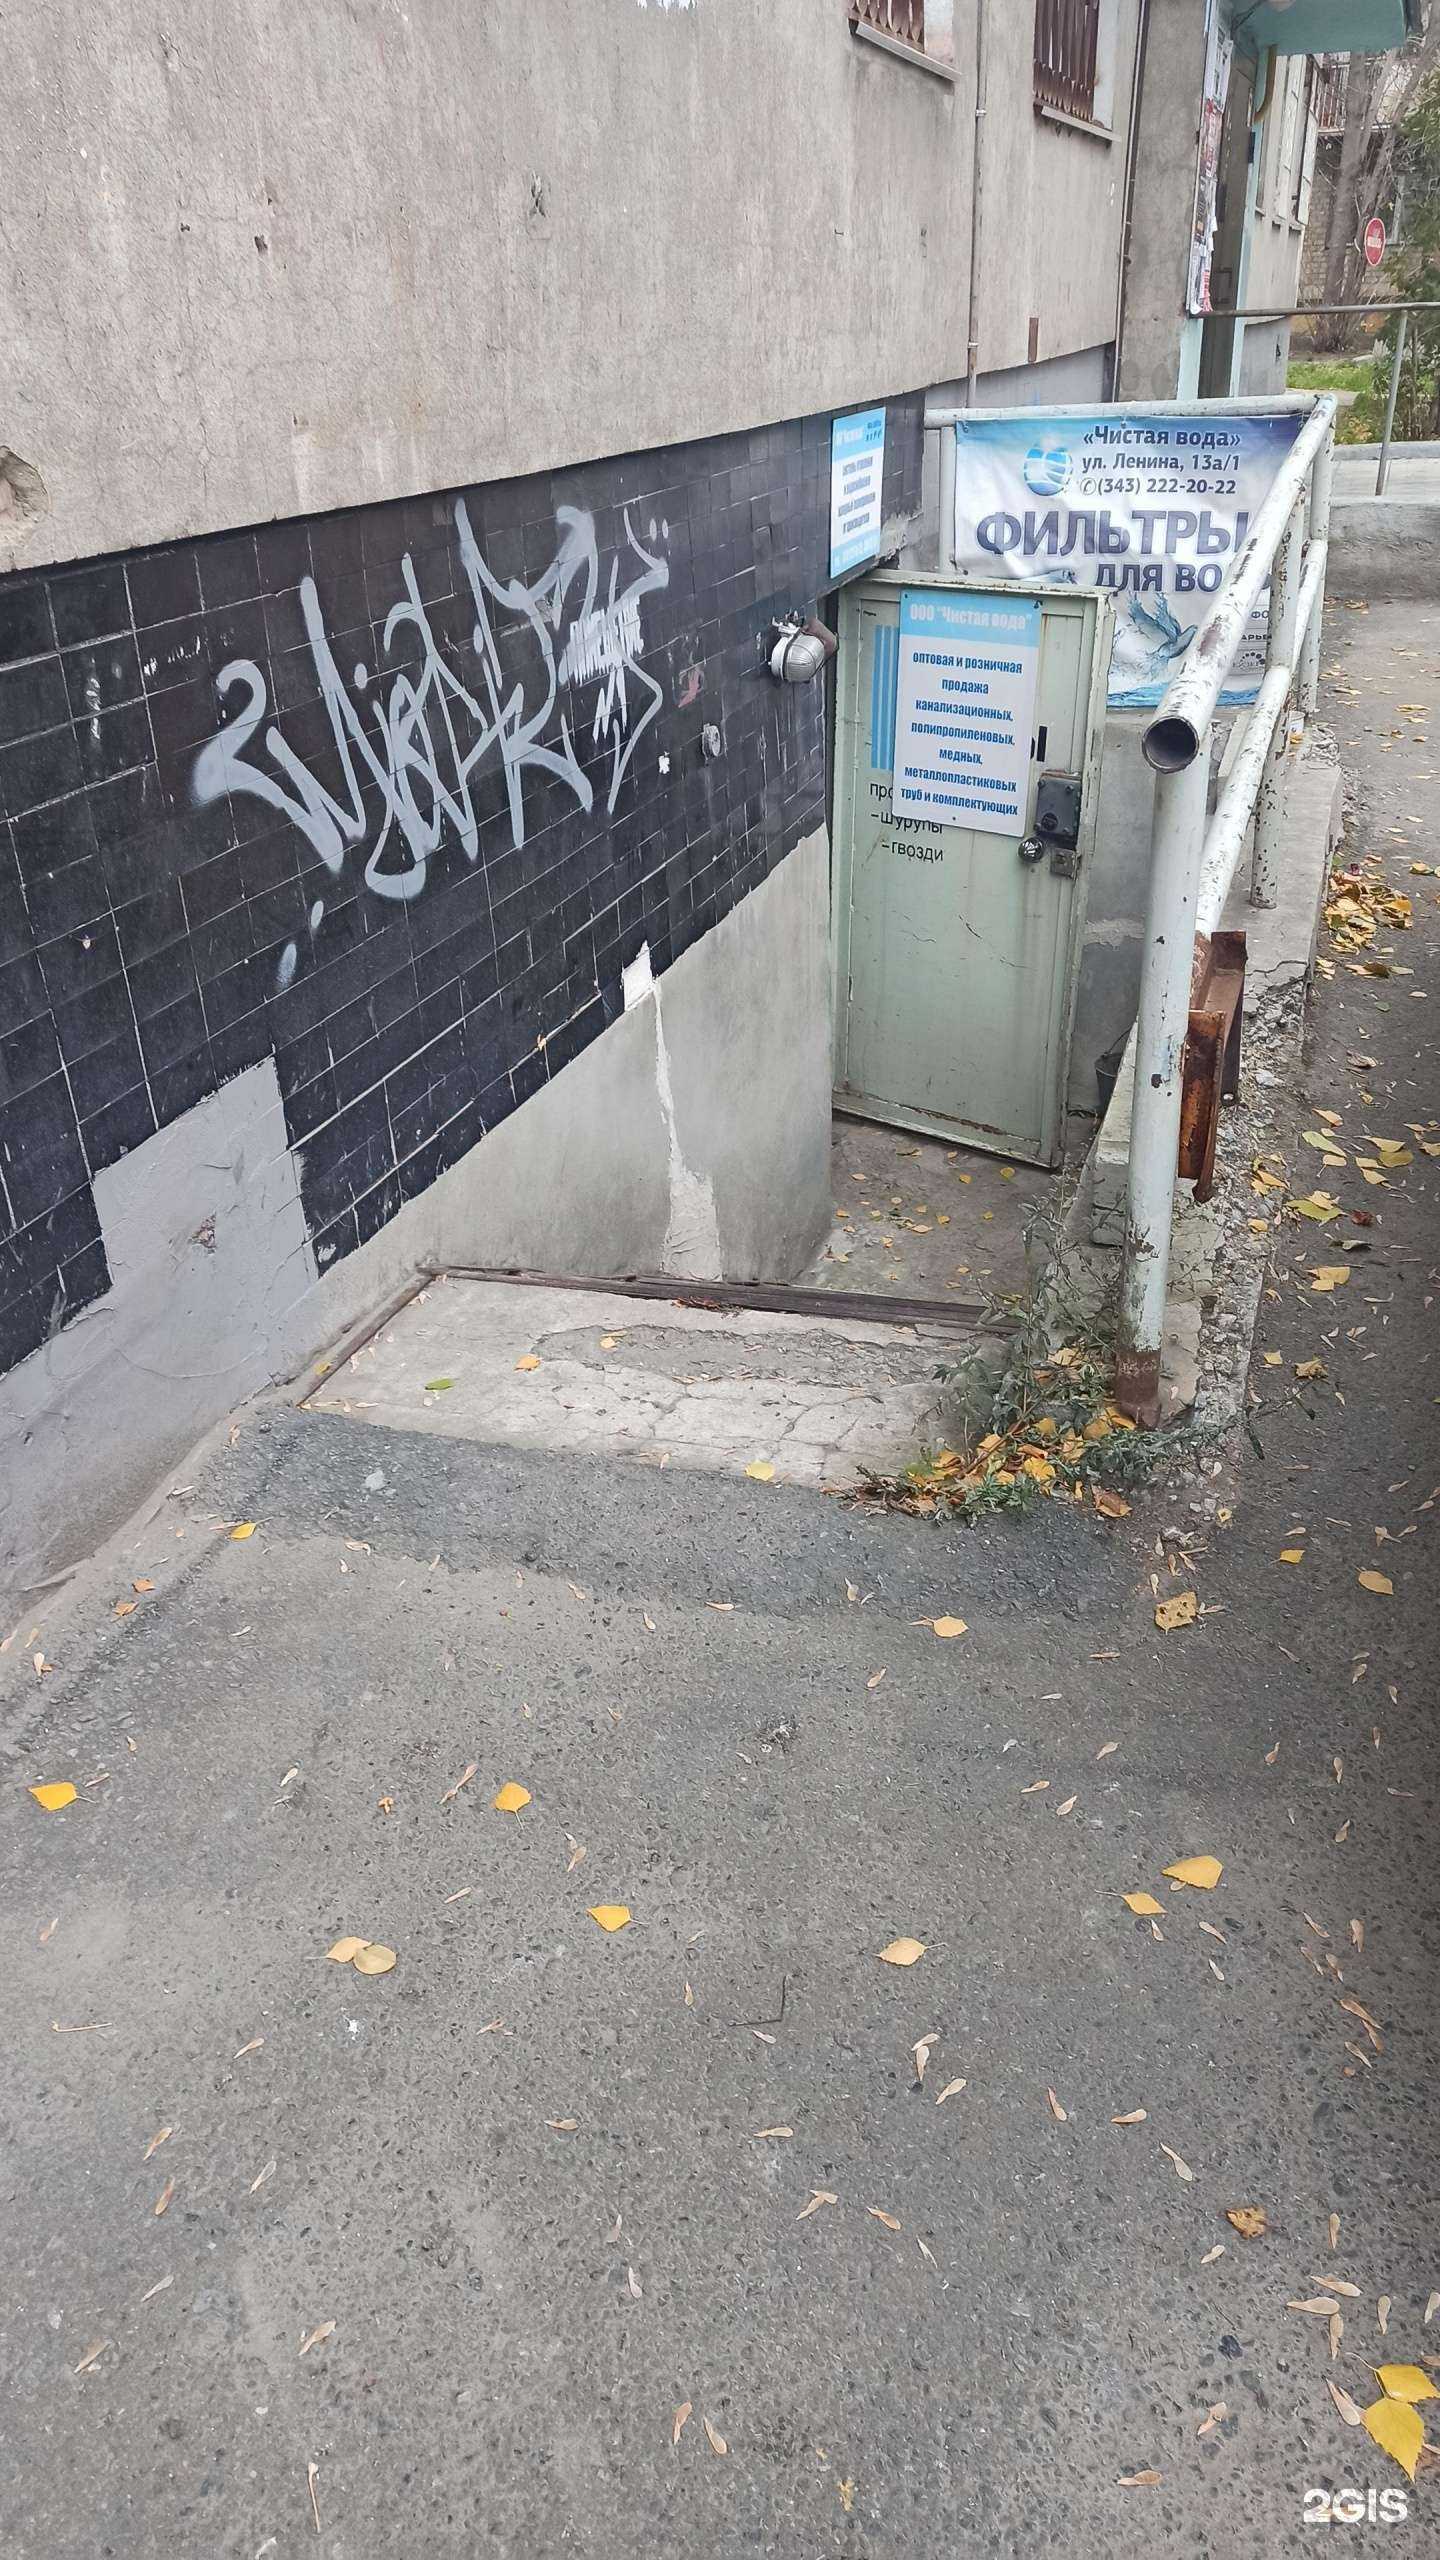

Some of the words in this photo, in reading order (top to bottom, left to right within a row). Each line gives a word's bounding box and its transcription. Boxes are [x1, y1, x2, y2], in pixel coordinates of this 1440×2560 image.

[1083, 425, 1169, 445] «Чистая
[1176, 431, 1241, 449] вода»
[1082, 457, 1107, 473] ул.
[1112, 453, 1185, 472] Ленина,
[1192, 454, 1240, 471] 13а/1
[1098, 477, 1141, 496] (343)
[1146, 478, 1236, 494] 222-20-22
[976, 510, 1249, 555] ФИЛЬТРЫ
[1095, 563, 1163, 592] ДЛЯ
[1174, 563, 1222, 592] ВО
[910, 603, 935, 621] ООО
[937, 606, 989, 627] "Чистая
[991, 613, 1033, 631] вода"
[913, 652, 955, 667] оптовая
[956, 658, 963, 667] и
[965, 658, 1023, 674] розничная
[942, 679, 989, 694] продажа
[916, 699, 1014, 721] канализационных,
[911, 722, 1016, 746] полипропиленовых,
[939, 748, 983, 765] медных,
[904, 766, 1017, 793] металлопластиковых
[901, 788, 922, 801] труб
[924, 791, 931, 802] и
[932, 793, 1018, 815] комплектующих
